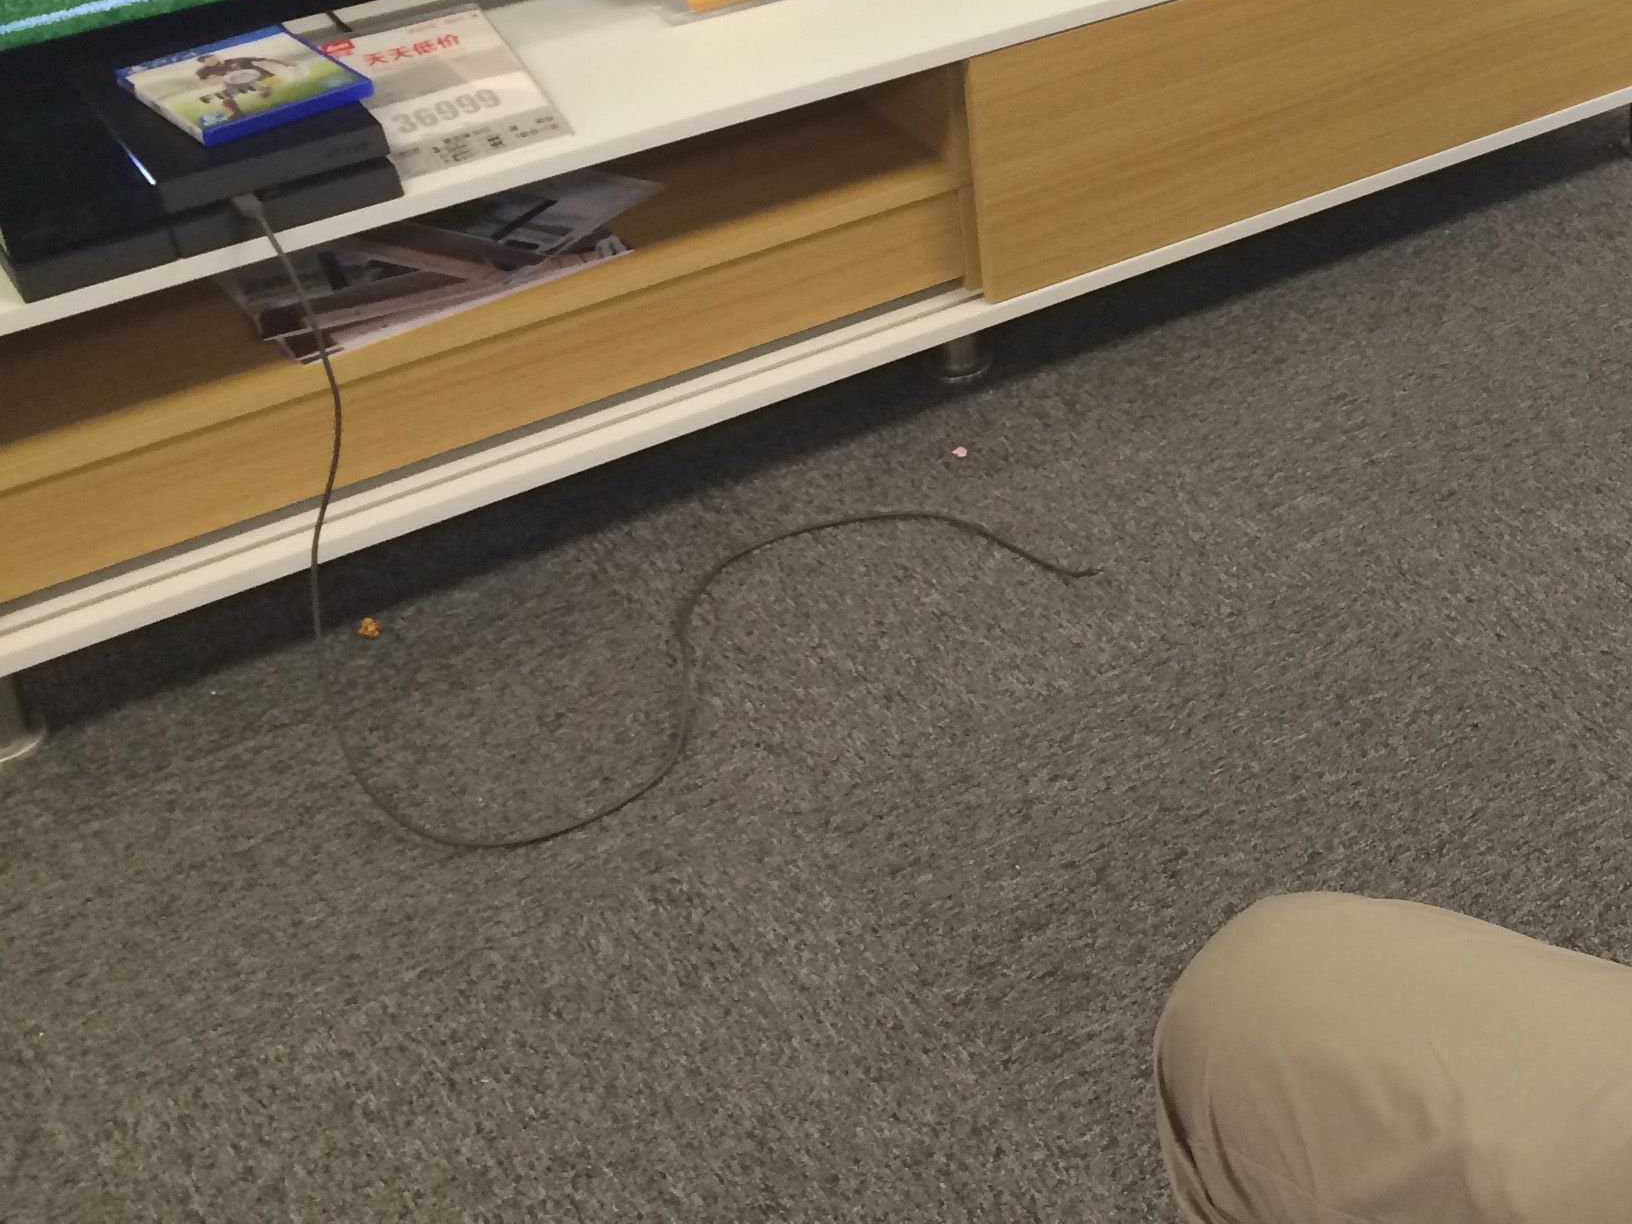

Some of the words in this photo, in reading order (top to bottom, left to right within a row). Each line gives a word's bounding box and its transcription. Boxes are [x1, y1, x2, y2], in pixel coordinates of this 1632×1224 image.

[364, 33, 460, 67] 天天低价
[392, 88, 500, 134] 36999
